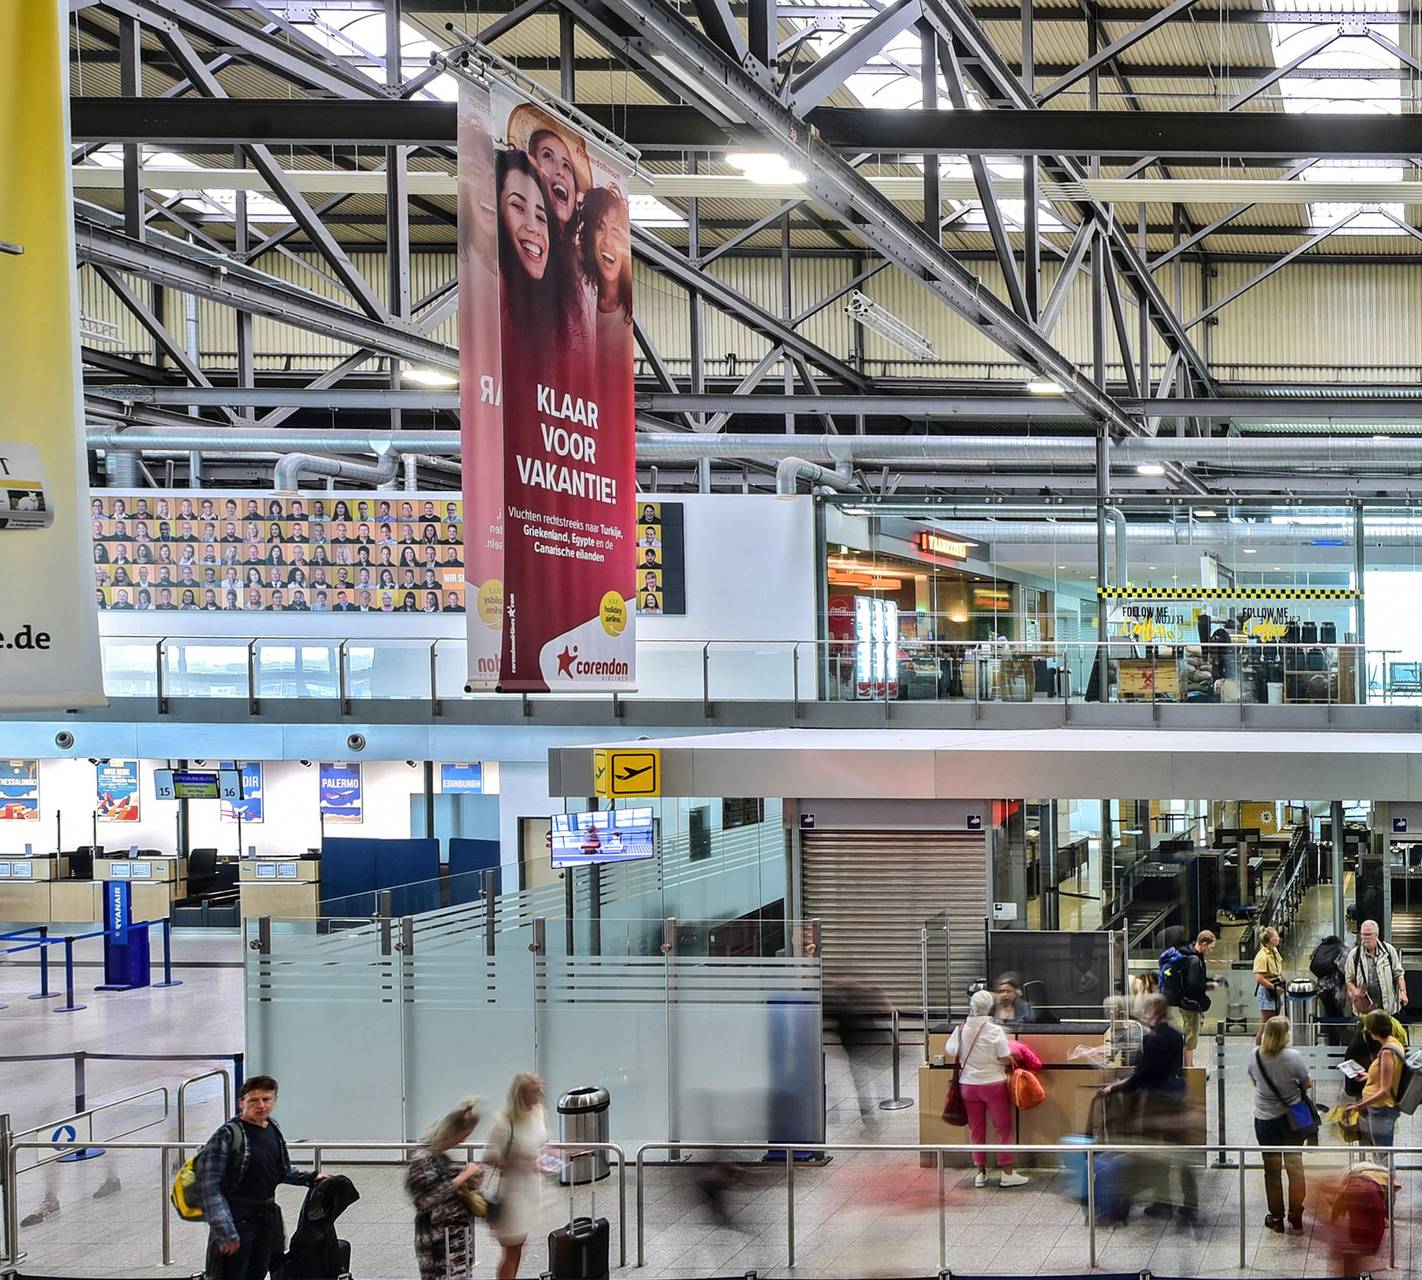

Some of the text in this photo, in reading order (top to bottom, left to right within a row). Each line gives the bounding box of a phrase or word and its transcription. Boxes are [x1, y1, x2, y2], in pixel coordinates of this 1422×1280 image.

[537, 384, 599, 430] KLAAR
[541, 423, 596, 465] VOOR
[515, 455, 617, 505] VAKANTIE!
[508, 505, 542, 523] Vluchten
[543, 514, 584, 531] rechtstreeks
[585, 523, 600, 534] naar
[600, 523, 624, 540] Turkije,
[523, 524, 614, 551] Griekenland, Egypte en de
[534, 541, 605, 563] Canarische eilanden
[1122, 606, 1169, 618] FOLLOW ME
[1242, 607, 1289, 618] FOLLOW ME
[576, 658, 629, 676] corendon
[159, 787, 171, 797] 15
[223, 787, 236, 797] 16
[321, 778, 359, 789] PALERMO
[443, 779, 481, 789] EDINBURGH
